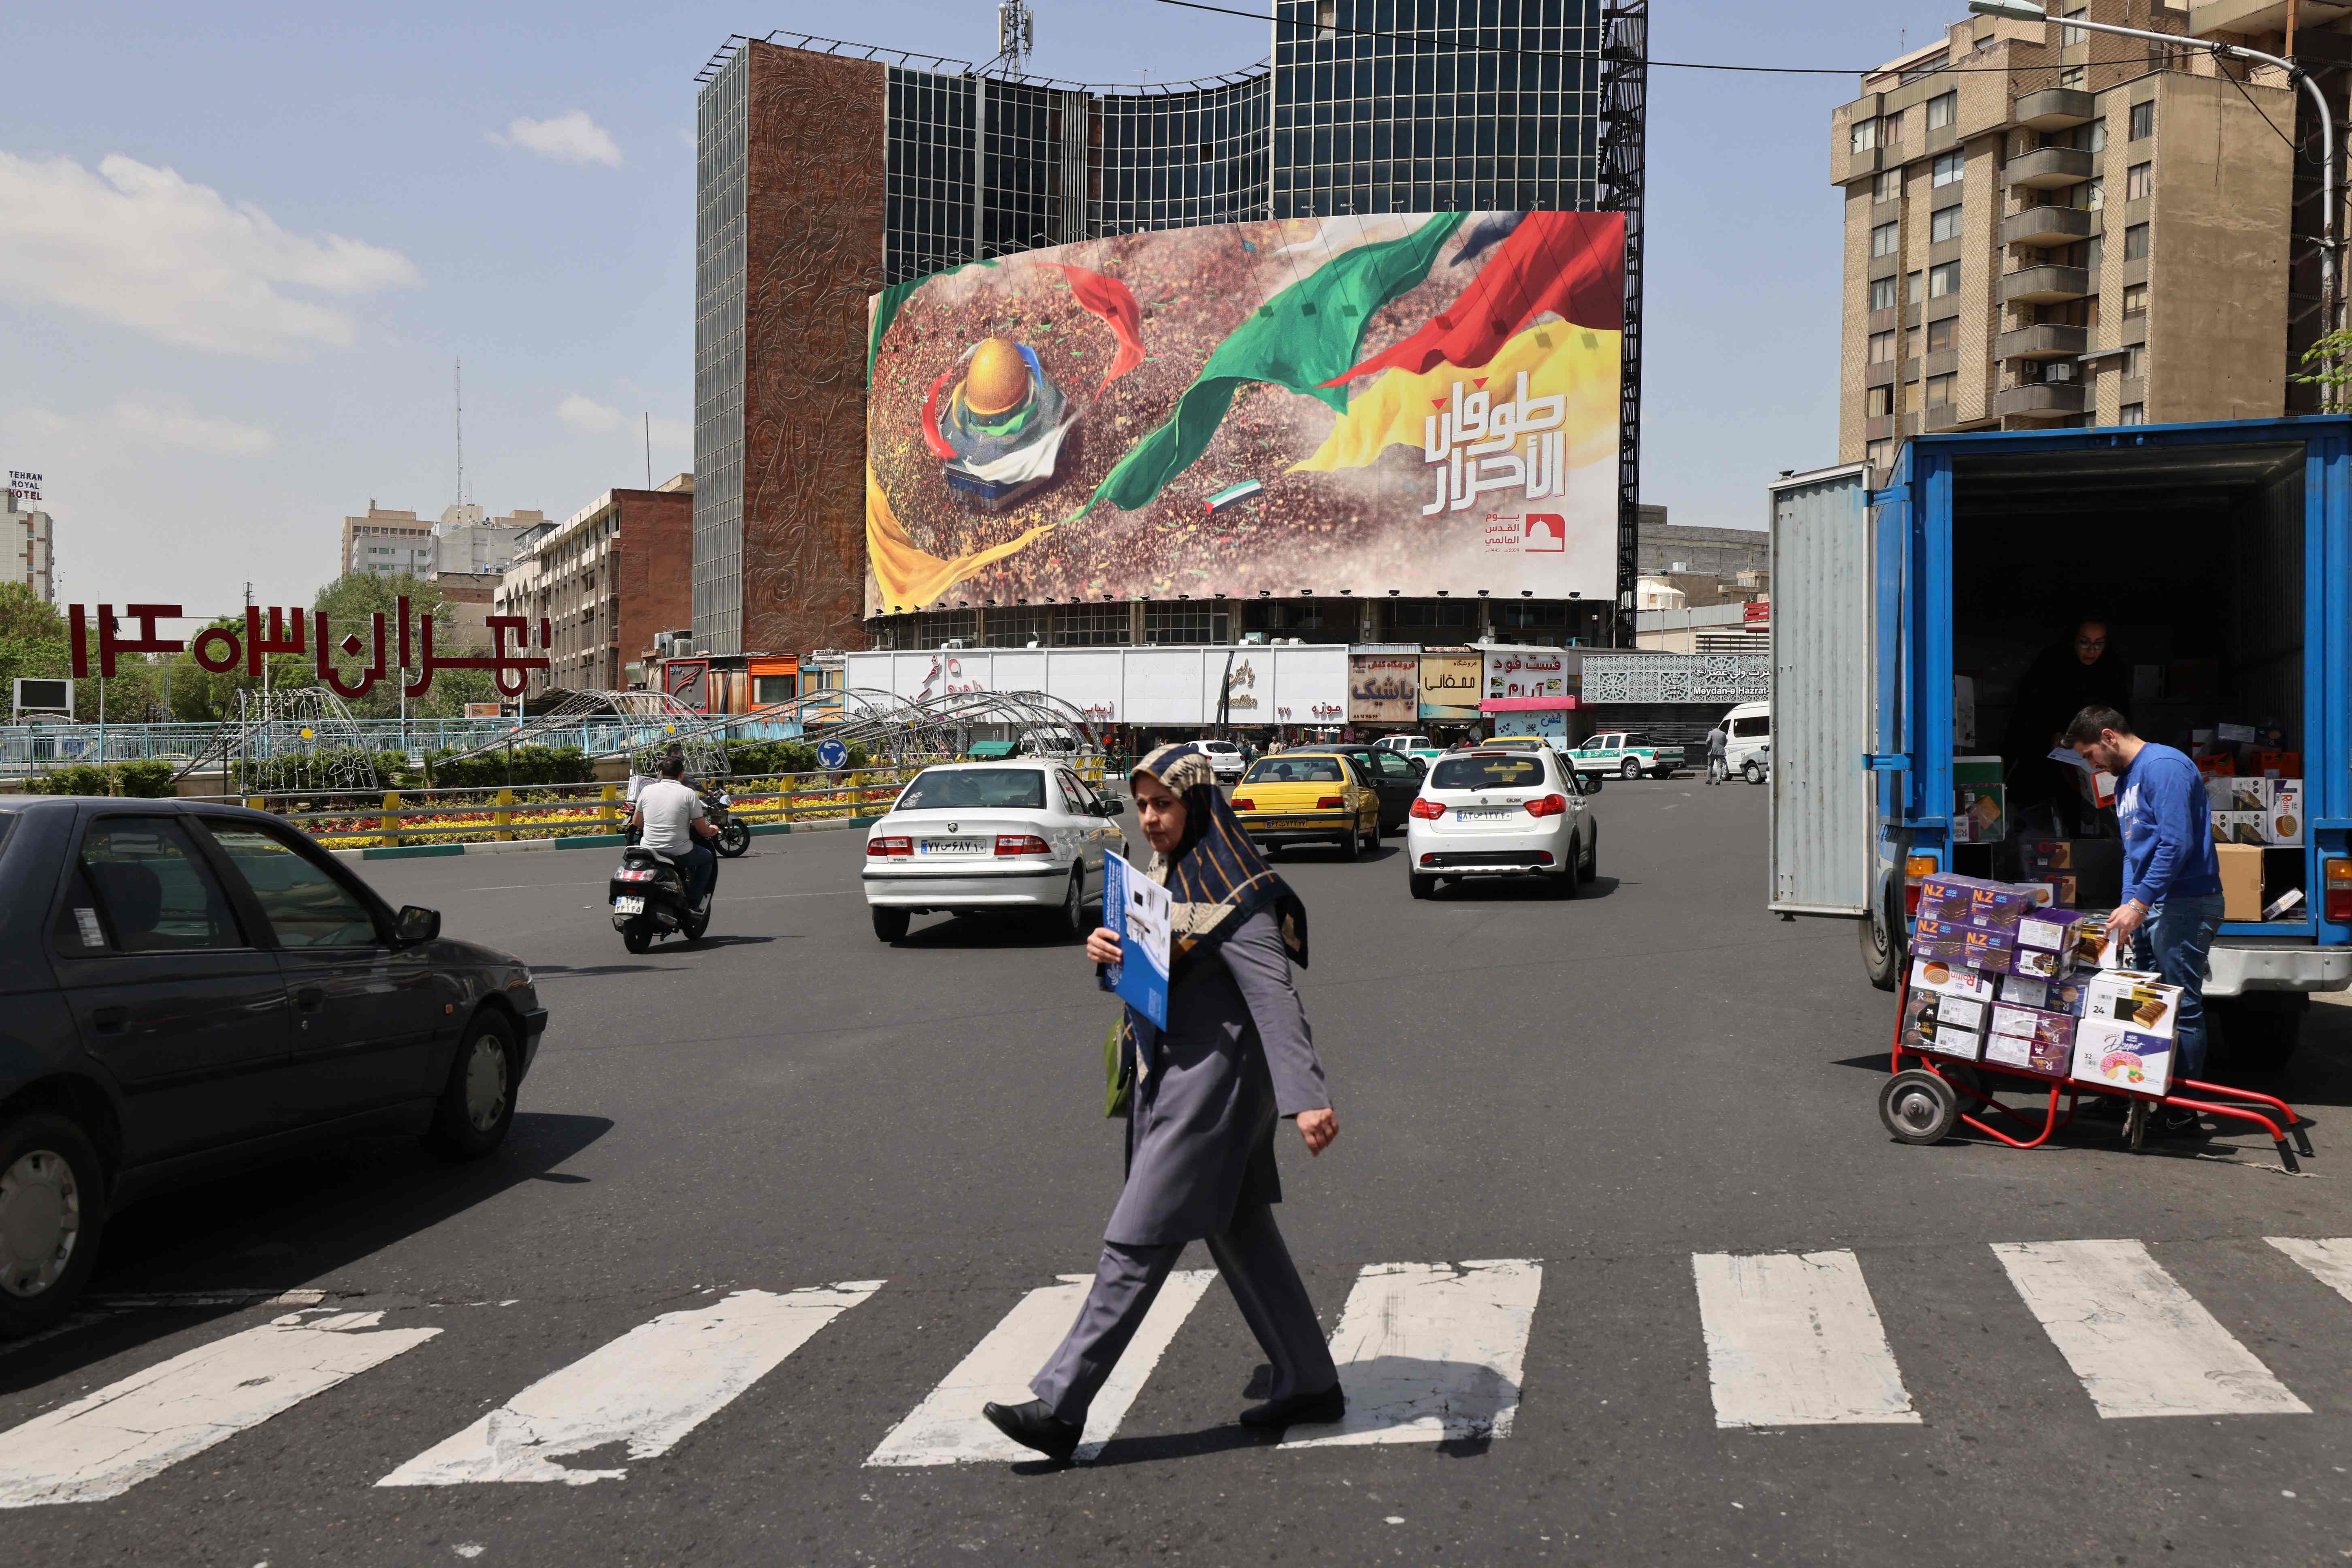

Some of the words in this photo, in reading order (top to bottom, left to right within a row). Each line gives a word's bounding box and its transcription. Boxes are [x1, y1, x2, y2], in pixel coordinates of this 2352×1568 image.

[1425, 371, 1565, 463] طوفان
[9, 471, 42, 481] TEHRAN
[12, 480, 39, 490] ROYAL
[9, 489, 42, 501] HOTEL
[1485, 524, 1519, 533] القدس
[1485, 536, 1519, 546] العالمي
[1493, 654, 1522, 673] فود
[1525, 655, 1561, 671] فست
[1730, 668, 1746, 679] ولی
[1353, 676, 1415, 710] پاشیک
[1693, 687, 1736, 696] Meydan-e
[1217, 694, 1258, 706] alin
[1311, 702, 1341, 714] موزه
[2092, 1006, 2104, 1014] 24
[2103, 1036, 2145, 1053] Donut
